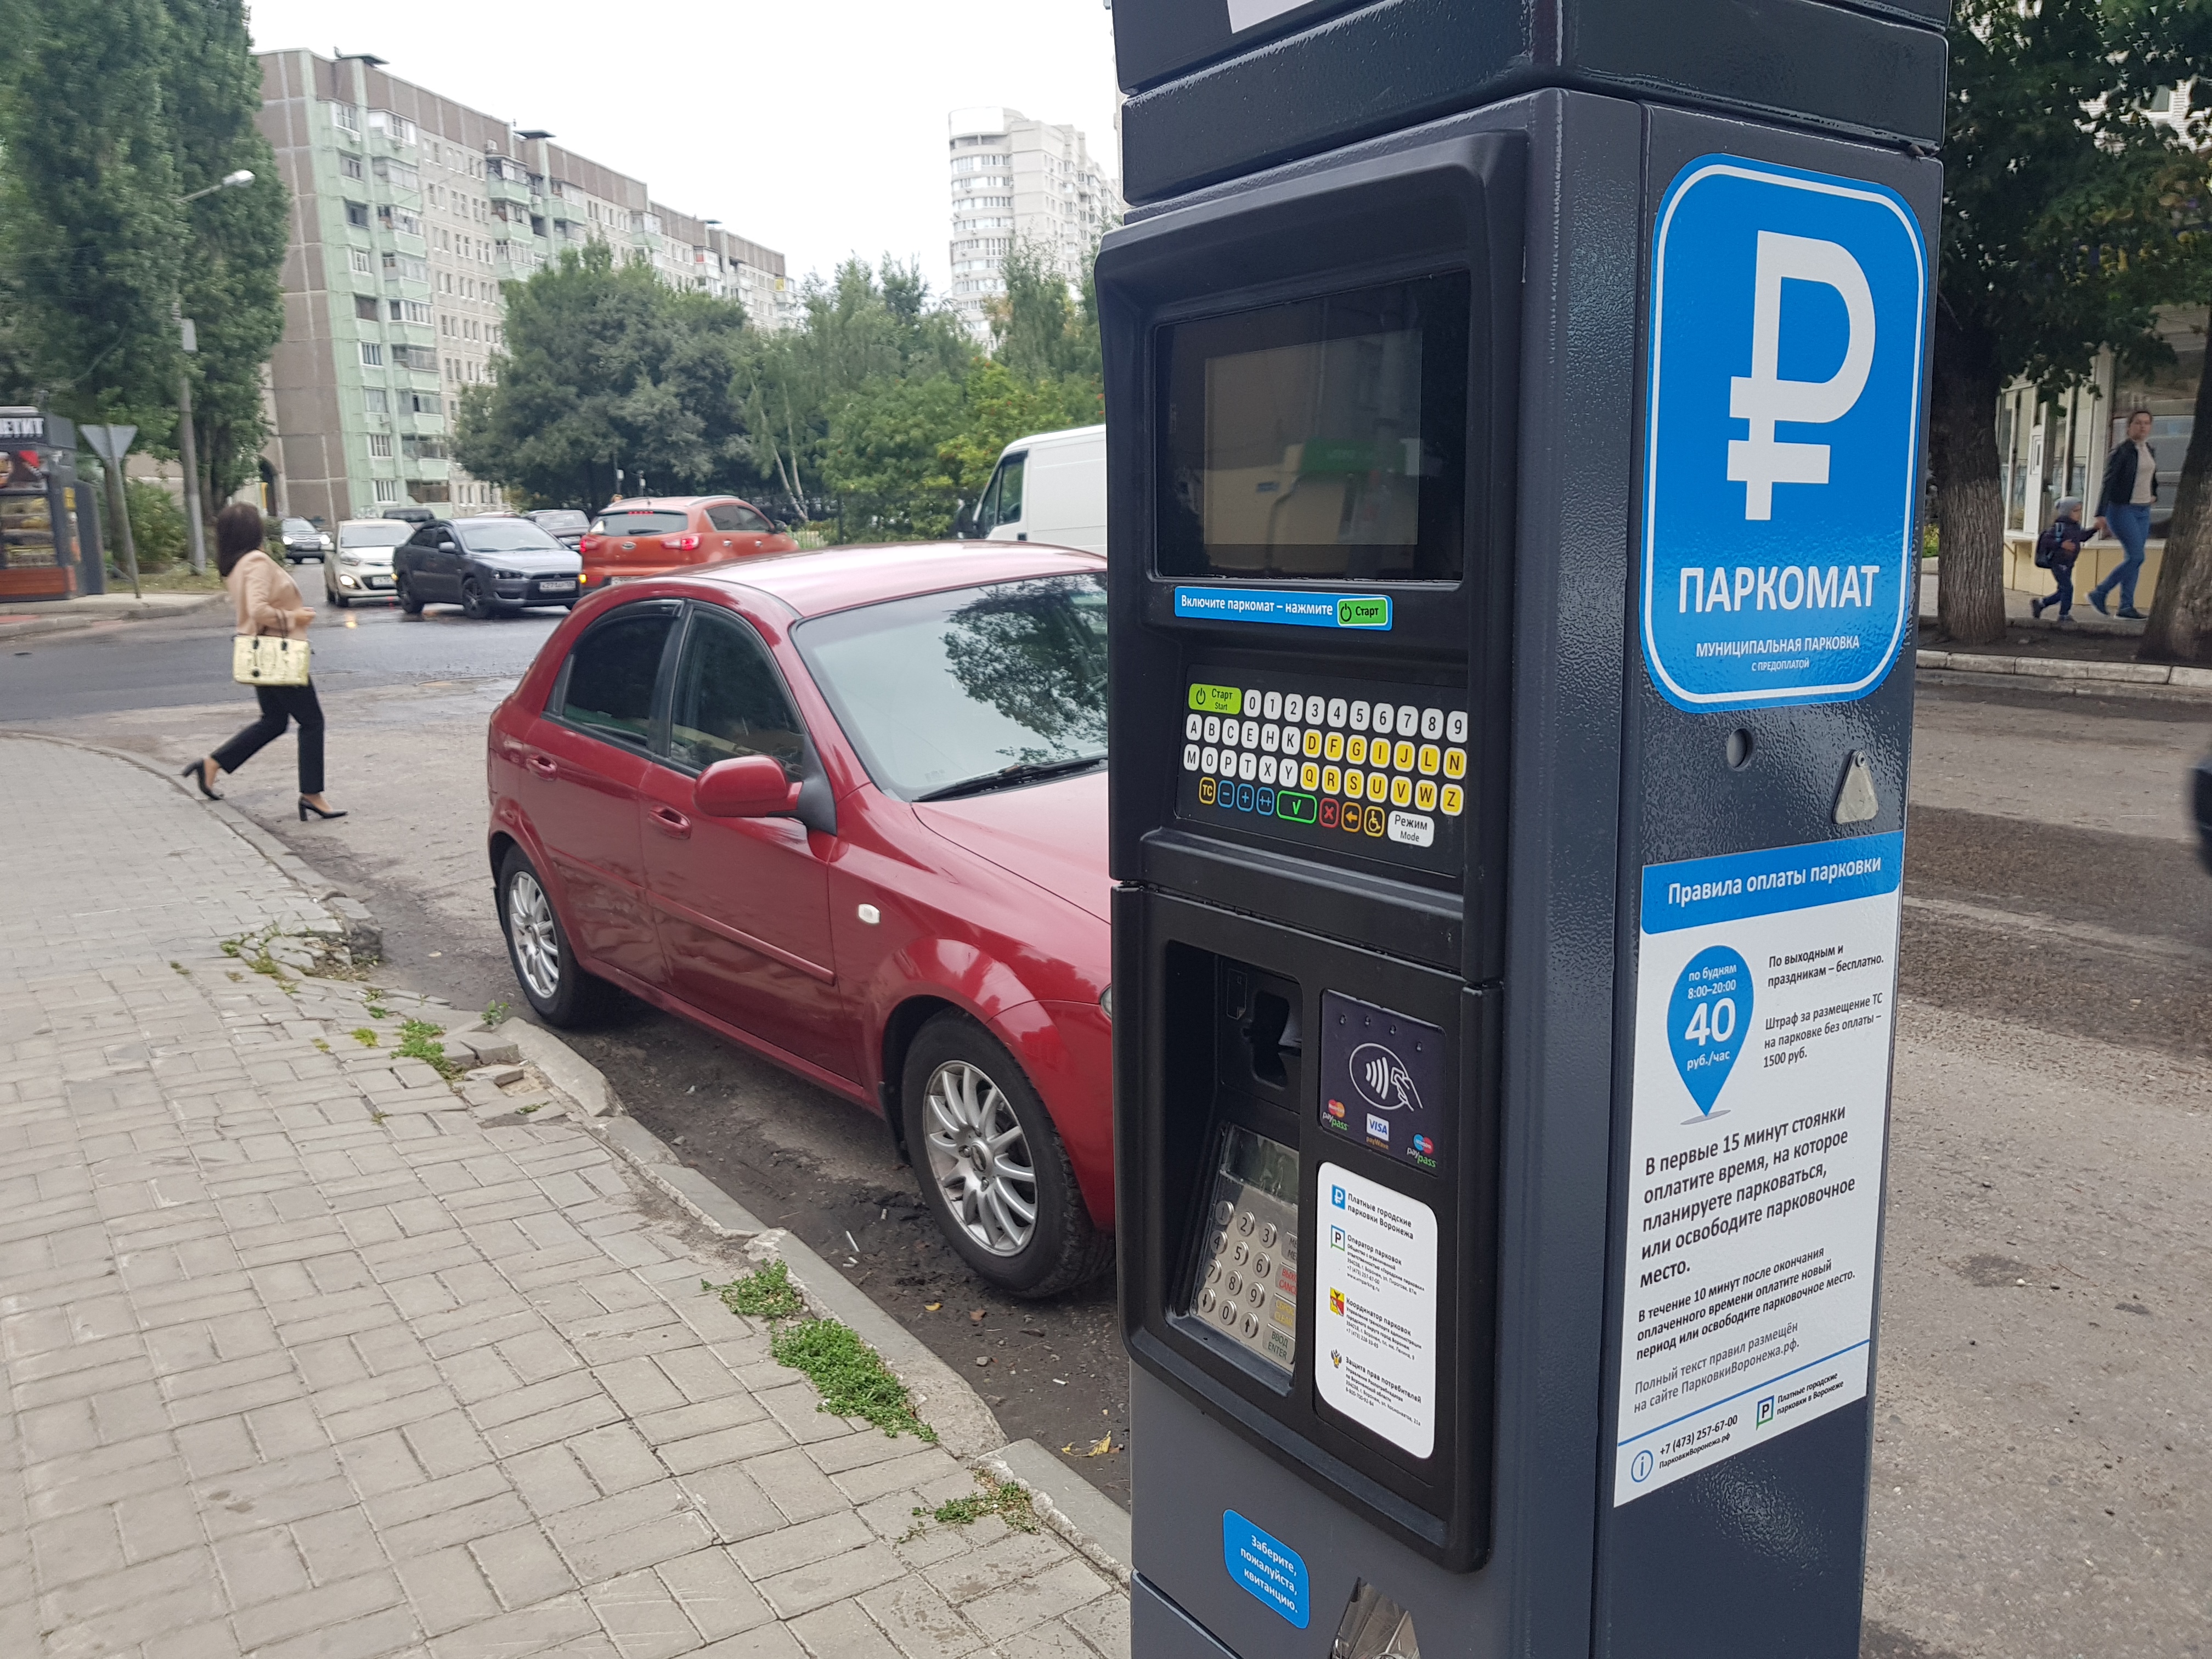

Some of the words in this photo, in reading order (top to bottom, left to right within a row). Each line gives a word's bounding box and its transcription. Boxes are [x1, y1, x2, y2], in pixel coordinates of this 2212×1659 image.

[1181, 595, 1225, 608] Включите
[1228, 600, 1274, 613] паркомат
[1285, 603, 1333, 615] нажмите
[1679, 565, 1879, 613] ПАРКОМАТ
[1355, 606, 1378, 618] Старт
[1696, 637, 1801, 657] МУНИЦИПАЛЬНАЯ
[1804, 635, 1859, 651] ПАРКОВКА
[1751, 662, 1756, 671] С
[1758, 657, 1809, 672] ПРЕДОПЛАТОЙ
[1211, 688, 1233, 701] Старт
[1215, 702, 1227, 710] Start
[1249, 697, 1255, 710] 0
[1271, 699, 1274, 712] 1
[1290, 701, 1296, 715] 2
[1312, 703, 1318, 717] 3
[1334, 706, 1340, 720] 4
[1356, 708, 1363, 723] 5
[1380, 711, 1386, 725] 6
[1404, 713, 1412, 728] 7
[1429, 716, 1436, 731] 8
[1454, 719, 1462, 735] 9
[1190, 721, 1197, 733] A
[1209, 723, 1215, 736] B
[1227, 726, 1234, 739] C
[1247, 728, 1253, 742] E
[1266, 731, 1274, 744] H
[1287, 733, 1295, 748] K
[1308, 736, 1316, 749] D
[1330, 738, 1338, 753] F
[1352, 742, 1361, 756] G
[1379, 745, 1381, 759] I
[1401, 748, 1408, 763] J
[1425, 751, 1432, 766] L
[1449, 755, 1459, 770] N
[1187, 751, 1196, 764] M
[1206, 754, 1213, 766] O
[1225, 757, 1232, 769] P
[1245, 759, 1251, 773] T
[1264, 763, 1271, 777] X
[1285, 766, 1293, 780] Y
[1306, 769, 1313, 783] Q
[1328, 772, 1334, 787] R
[1350, 776, 1357, 790] S
[1373, 779, 1381, 794] U
[1397, 783, 1406, 798] V
[1420, 787, 1432, 803] W
[1447, 791, 1455, 807] Z
[1395, 814, 1427, 830] Режим
[1400, 830, 1419, 842] Mode
[1668, 878, 1741, 907] Правила
[1747, 868, 1805, 891] оплаты
[1810, 856, 1881, 883] парковки
[1689, 971, 1700, 981] по
[1702, 964, 1736, 980] будням
[1768, 967, 1826, 989] праздникам
[1836, 955, 1883, 972] бесплатно.
[1769, 956, 1781, 968] По
[1784, 946, 1835, 964] выходным
[1837, 945, 1843, 954] и
[1688, 979, 1736, 999] 8:00–20:00
[1685, 997, 1735, 1046] 40
[1765, 1012, 1798, 1030] Штраф
[1801, 1012, 1810, 1022] за
[1813, 998, 1870, 1022] размещение
[1872, 992, 1882, 1005] ТС
[1764, 1039, 1775, 1049] на
[1778, 1027, 1821, 1046] парковке
[1824, 1022, 1839, 1034] без
[1842, 1014, 1874, 1030] оплаты
[1687, 1051, 1729, 1071] руб./час
[1763, 1052, 1786, 1068] 1500
[1788, 1046, 1807, 1064] руб.
[1369, 1119, 1387, 1135] VISA
[1646, 1157, 1655, 1175] В
[1660, 1143, 1718, 1171] первые
[1723, 1132, 1739, 1153] 15
[1743, 1122, 1788, 1147] минут
[1792, 1106, 1845, 1132] стоянки
[1644, 1171, 1714, 1203] оплатите
[1719, 1156, 1768, 1183] время,
[1773, 1148, 1789, 1164] на
[1793, 1131, 1847, 1158] которое
[1348, 1193, 1375, 1211] Платные
[1377, 1207, 1411, 1227] городские
[1643, 1192, 1731, 1232] планируете
[1736, 1164, 1826, 1202] парковаться,
[1221, 1206, 1224, 1220] 1
[1240, 1217, 1247, 1232] 2
[1262, 1228, 1269, 1242] 3
[1347, 1205, 1378, 1223] парковки
[1379, 1217, 1413, 1239] Воронежа
[1642, 1238, 1671, 1260] или
[1675, 1209, 1762, 1248] освободите
[1767, 1178, 1854, 1218] парковочное
[1214, 1236, 1220, 1249] 4
[1234, 1246, 1242, 1260] 5
[1256, 1259, 1262, 1273] 6
[1347, 1234, 1373, 1252] Оператор
[1375, 1248, 1401, 1265] парковок
[1208, 1264, 1215, 1278] 7
[1229, 1276, 1235, 1290] 8
[1250, 1289, 1257, 1302] 9
[1639, 1310, 1645, 1322] В
[1648, 1296, 1691, 1318] течение
[1694, 1288, 1706, 1302] 10
[1708, 1278, 1740, 1297] минут
[1742, 1267, 1770, 1285] после
[1773, 1248, 1824, 1273] окончания
[1640, 1261, 1690, 1288] место.
[1223, 1306, 1229, 1320] 0
[1346, 1297, 1382, 1322] Координатор
[1384, 1318, 1410, 1336] парковок
[1637, 1308, 1706, 1341] оплаченного
[1708, 1290, 1753, 1316] времени
[1756, 1274, 1798, 1297] оплатите
[1801, 1259, 1831, 1280] новый
[1637, 1337, 1676, 1360] период
[1679, 1328, 1699, 1344] или
[1701, 1306, 1760, 1335] освободите
[1763, 1282, 1824, 1312] парковочное
[1826, 1271, 1854, 1288] место.
[1268, 1342, 1287, 1359] ENTER
[1272, 1331, 1288, 1348] ВВОД
[1634, 1400, 1646, 1413] на
[1650, 1387, 1678, 1406] сайте
[1681, 1338, 1799, 1393] ПарковкиВоронежа.рф.
[1635, 1366, 1677, 1394] Полный
[1680, 1358, 1707, 1376] текст
[1709, 1343, 1745, 1365] правил
[1748, 1322, 1797, 1352] размещён
[1346, 1356, 1365, 1373] Защита
[1367, 1369, 1380, 1380] прав
[1381, 1377, 1421, 1403] потребителей
[1777, 1397, 1807, 1414] парковки
[1813, 1381, 1843, 1399] Воронеже
[1778, 1387, 1805, 1403] Платные
[1806, 1373, 1837, 1391] городские
[1659, 1432, 1730, 1469] ПарковкиВоронежа.рф
[1660, 1442, 1671, 1454] +7
[1673, 1432, 1694, 1452] (473)
[1696, 1414, 1737, 1440] 257-67-00
[1240, 1548, 1296, 1595] пожалуйста,
[1251, 1534, 1296, 1576] Заберите,
[1244, 1568, 1297, 1613] квитанцию.
